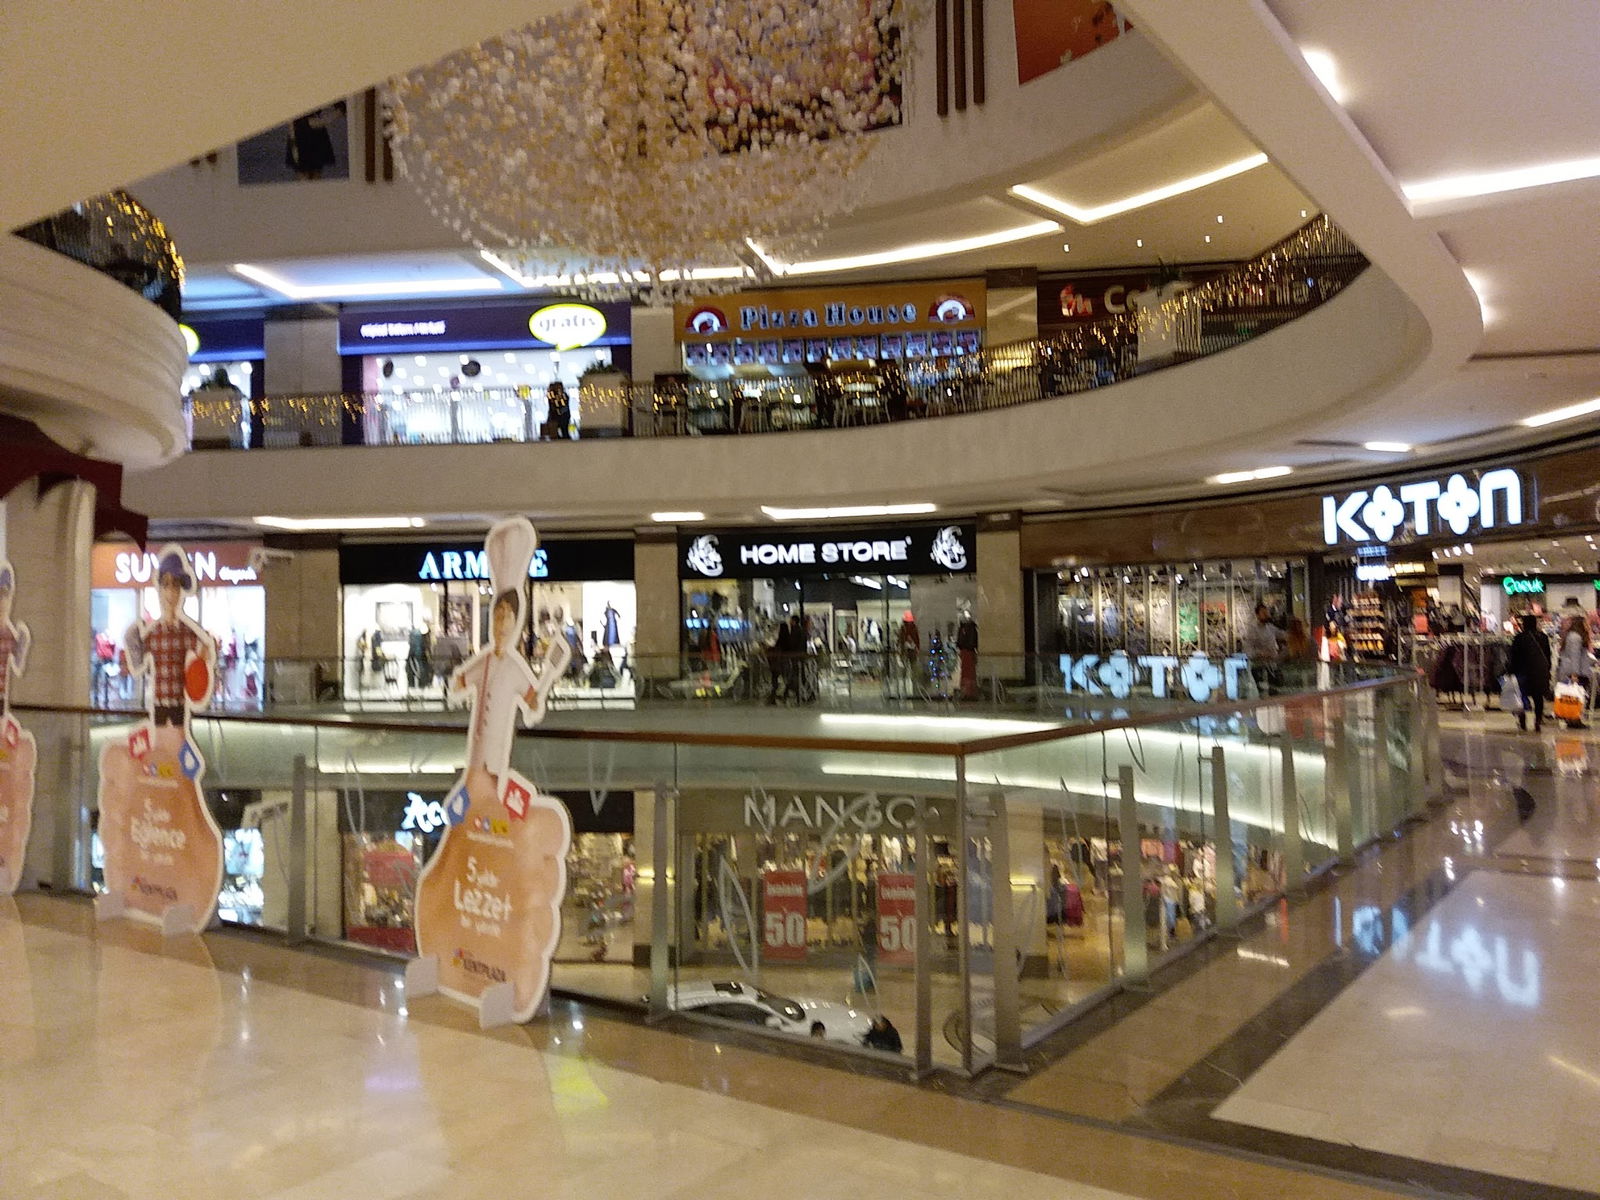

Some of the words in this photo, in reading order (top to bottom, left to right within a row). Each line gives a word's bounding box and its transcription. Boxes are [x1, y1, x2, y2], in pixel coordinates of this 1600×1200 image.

[739, 304, 819, 331] Pizza
[823, 302, 918, 327] House
[1322, 468, 1523, 546] KOTON
[115, 551, 217, 583] SUN
[418, 549, 549, 580] ARME
[740, 544, 816, 565] HOME
[821, 540, 908, 563] STORE
[453, 878, 514, 922] Lezzet
[765, 911, 805, 948] 50
